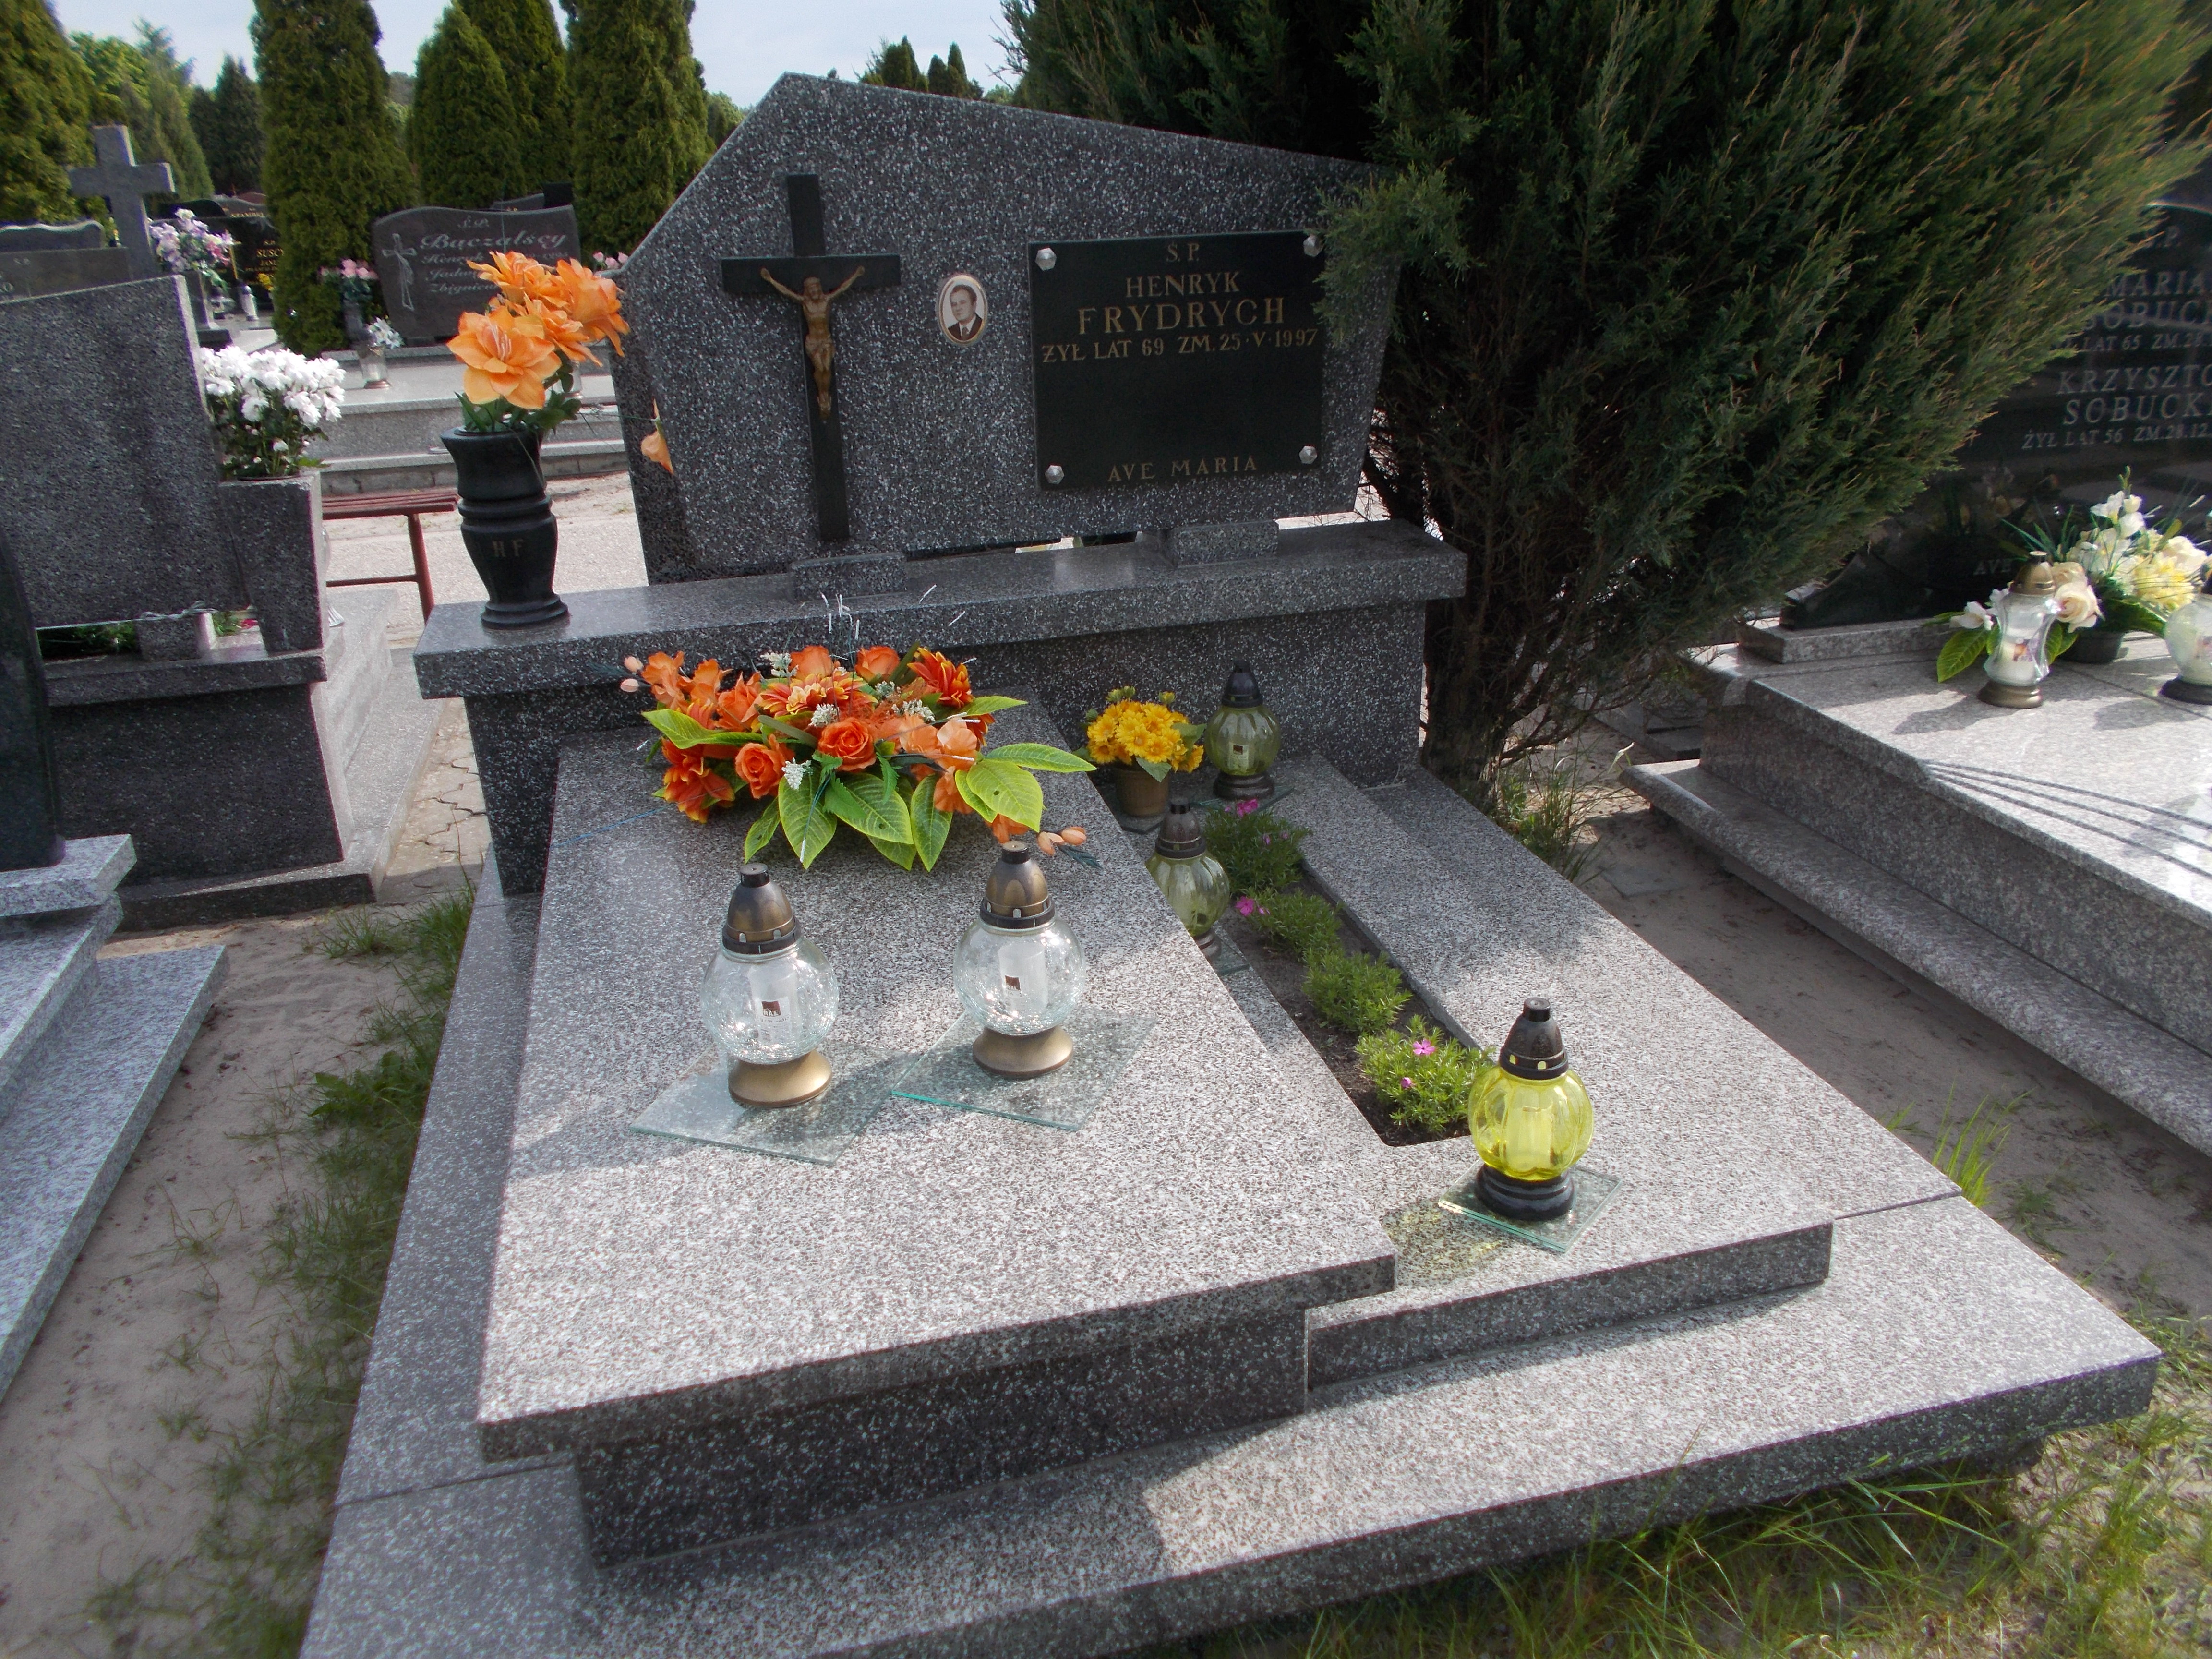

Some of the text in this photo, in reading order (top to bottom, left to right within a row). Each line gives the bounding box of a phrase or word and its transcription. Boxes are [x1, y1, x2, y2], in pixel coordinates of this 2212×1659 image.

[1126, 271, 1241, 298] HENRYK
[1078, 297, 1284, 335] FRYDRYCH
[1094, 339, 1132, 359] LAT
[1142, 337, 1165, 357] 69
[1108, 456, 1257, 482] AVE MARIA
